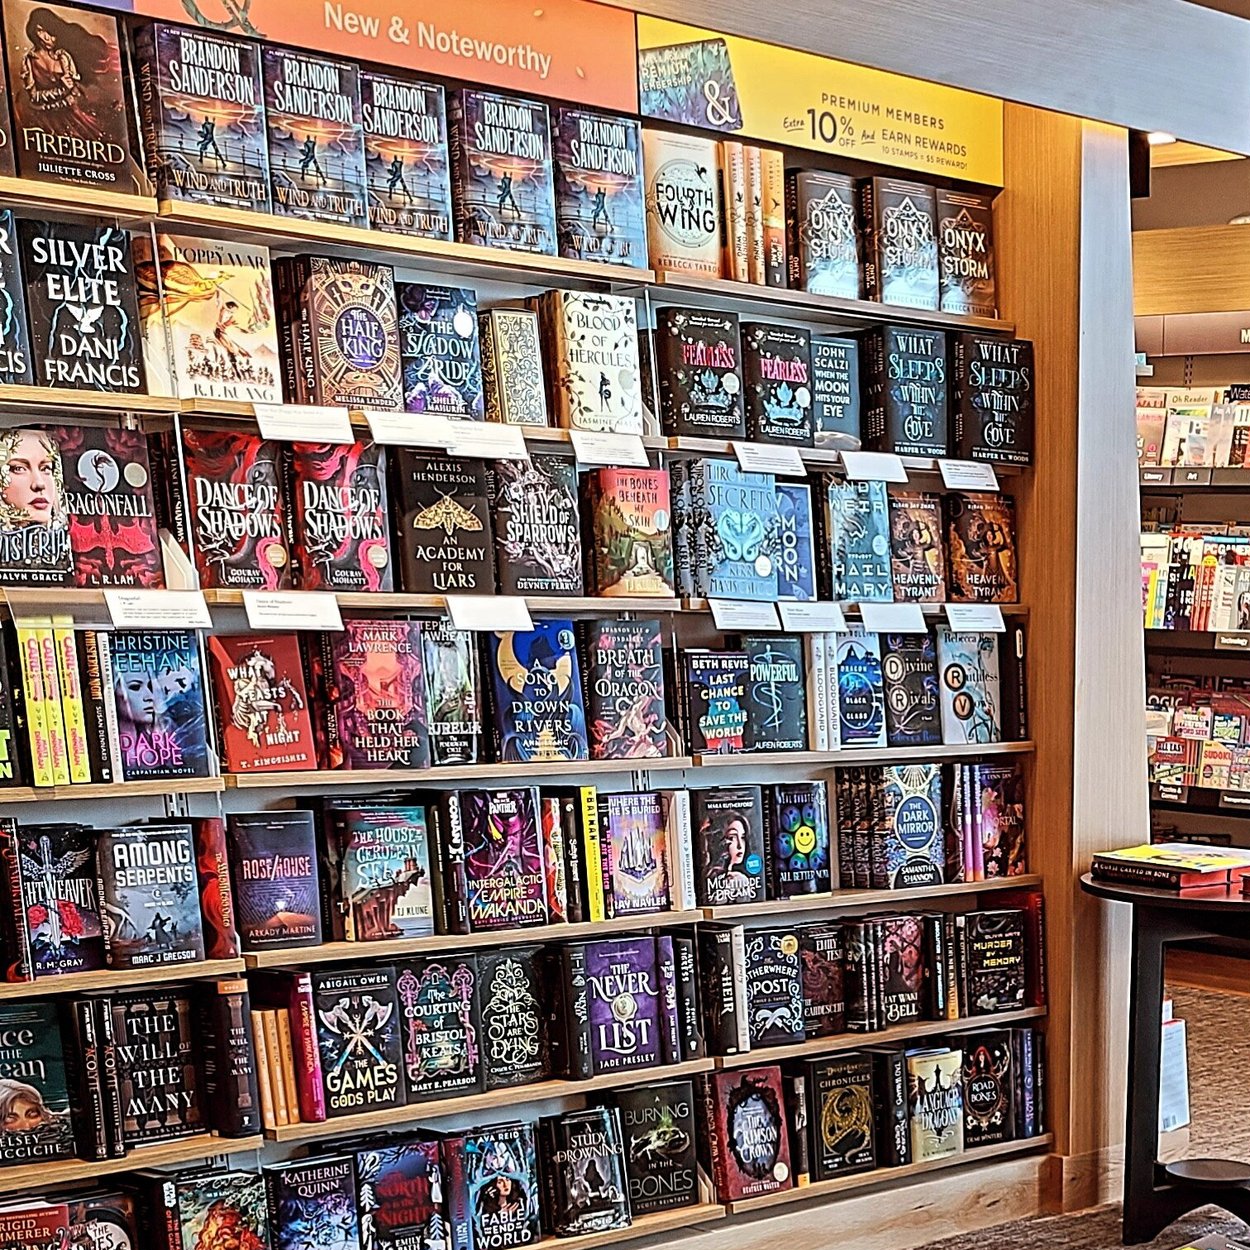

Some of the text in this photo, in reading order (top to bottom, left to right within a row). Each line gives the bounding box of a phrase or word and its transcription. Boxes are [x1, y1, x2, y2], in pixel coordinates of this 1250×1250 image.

[325, 1, 552, 79] New & Noteworthy
[181, 37, 240, 74] BRANDON
[169, 61, 255, 105] SANDERSON
[821, 93, 945, 130] PREMIUM MEMBERS
[783, 117, 805, 128] Extra
[807, 109, 837, 143] 10
[861, 130, 875, 140] And
[22, 126, 125, 165] FIREBIRD
[839, 139, 856, 148] OFF
[882, 129, 967, 157] EARN REWARDS
[38, 162, 116, 182] JULIETTE CROSS
[655, 182, 714, 209] FOURTH
[657, 200, 716, 234] WING
[32, 237, 127, 274] SILVER
[46, 273, 121, 305] ELITE
[60, 334, 120, 361] DANI
[817, 346, 845, 358] JOHN
[45, 359, 140, 388] FRANCIS
[815, 358, 849, 369] SCALZI
[815, 380, 849, 394] MOON
[412, 472, 476, 484] HENDERSON
[426, 462, 461, 473] ALEXIS
[194, 478, 278, 509] DANCE OF
[198, 508, 281, 538] SHADOWS
[507, 523, 576, 544] SPARROWS
[892, 573, 942, 586] HEAVENLY
[900, 585, 936, 598] TYRANT
[120, 731, 179, 750] DARK
[125, 746, 183, 766] HOPE
[902, 809, 930, 822] DARK
[899, 822, 935, 834] MIRROR
[113, 840, 190, 868] AMONG
[115, 865, 193, 887] SERPENTS
[470, 899, 547, 920] WAKANDA
[588, 973, 658, 997] NEVER
[600, 1018, 650, 1050] LIST
[117, 1042, 177, 1063] WILL
[326, 1065, 397, 1090] GAMES
[126, 1091, 195, 1116] MANY
[330, 1088, 397, 1108] GODS PLAY
[281, 1161, 351, 1185] KATHERINE
[481, 1210, 525, 1226] FABLE
[476, 1226, 532, 1248] WORLD
